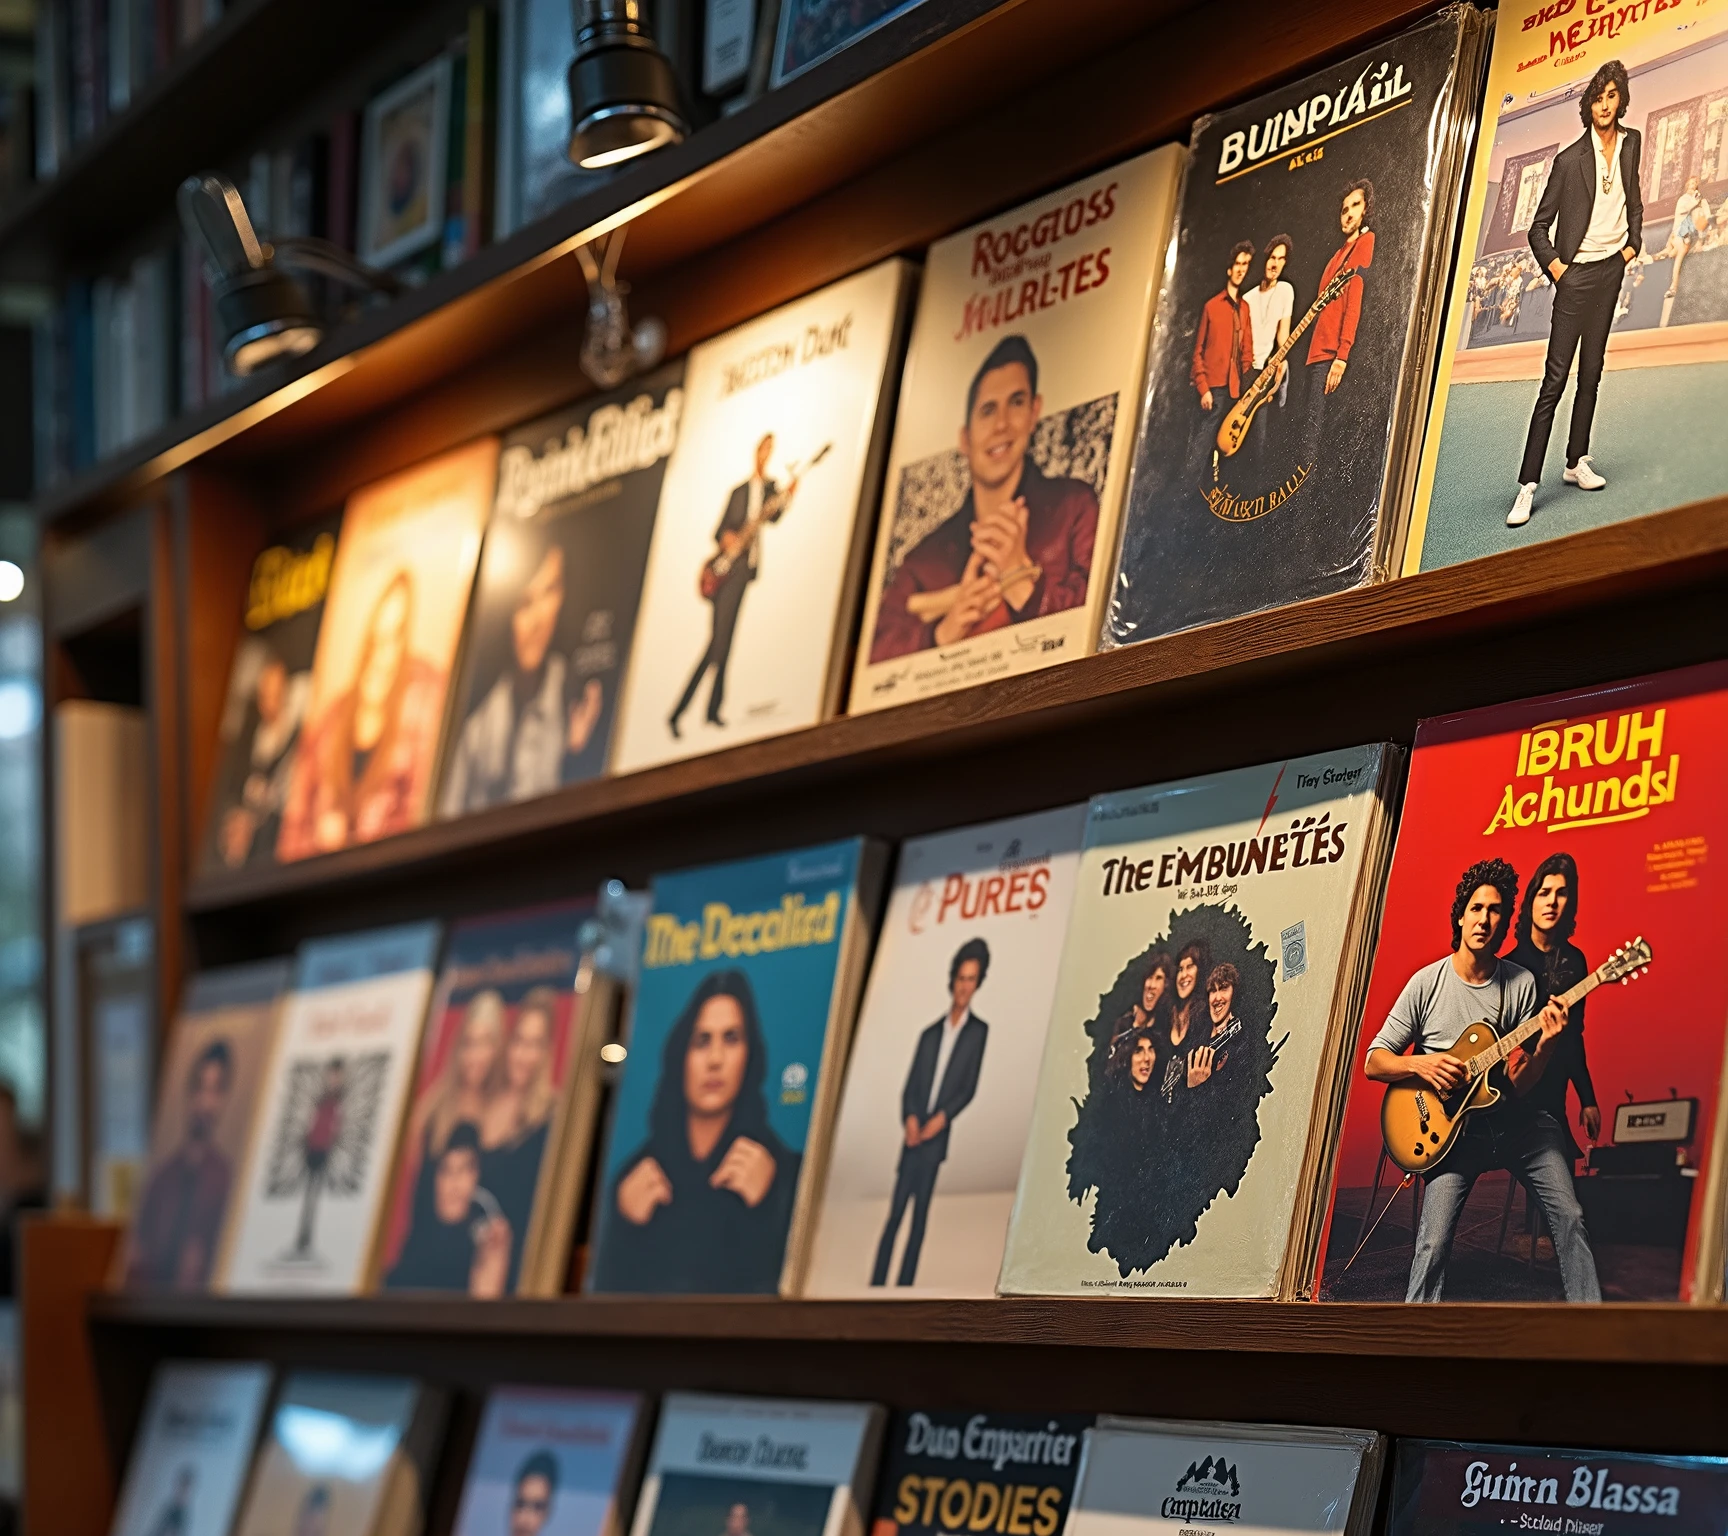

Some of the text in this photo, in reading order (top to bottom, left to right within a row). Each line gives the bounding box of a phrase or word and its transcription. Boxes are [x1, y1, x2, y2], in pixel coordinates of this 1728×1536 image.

[936, 868, 1051, 924] PURES
[1102, 856, 1154, 896] The
[1565, 1465, 1681, 1516] Blassa
